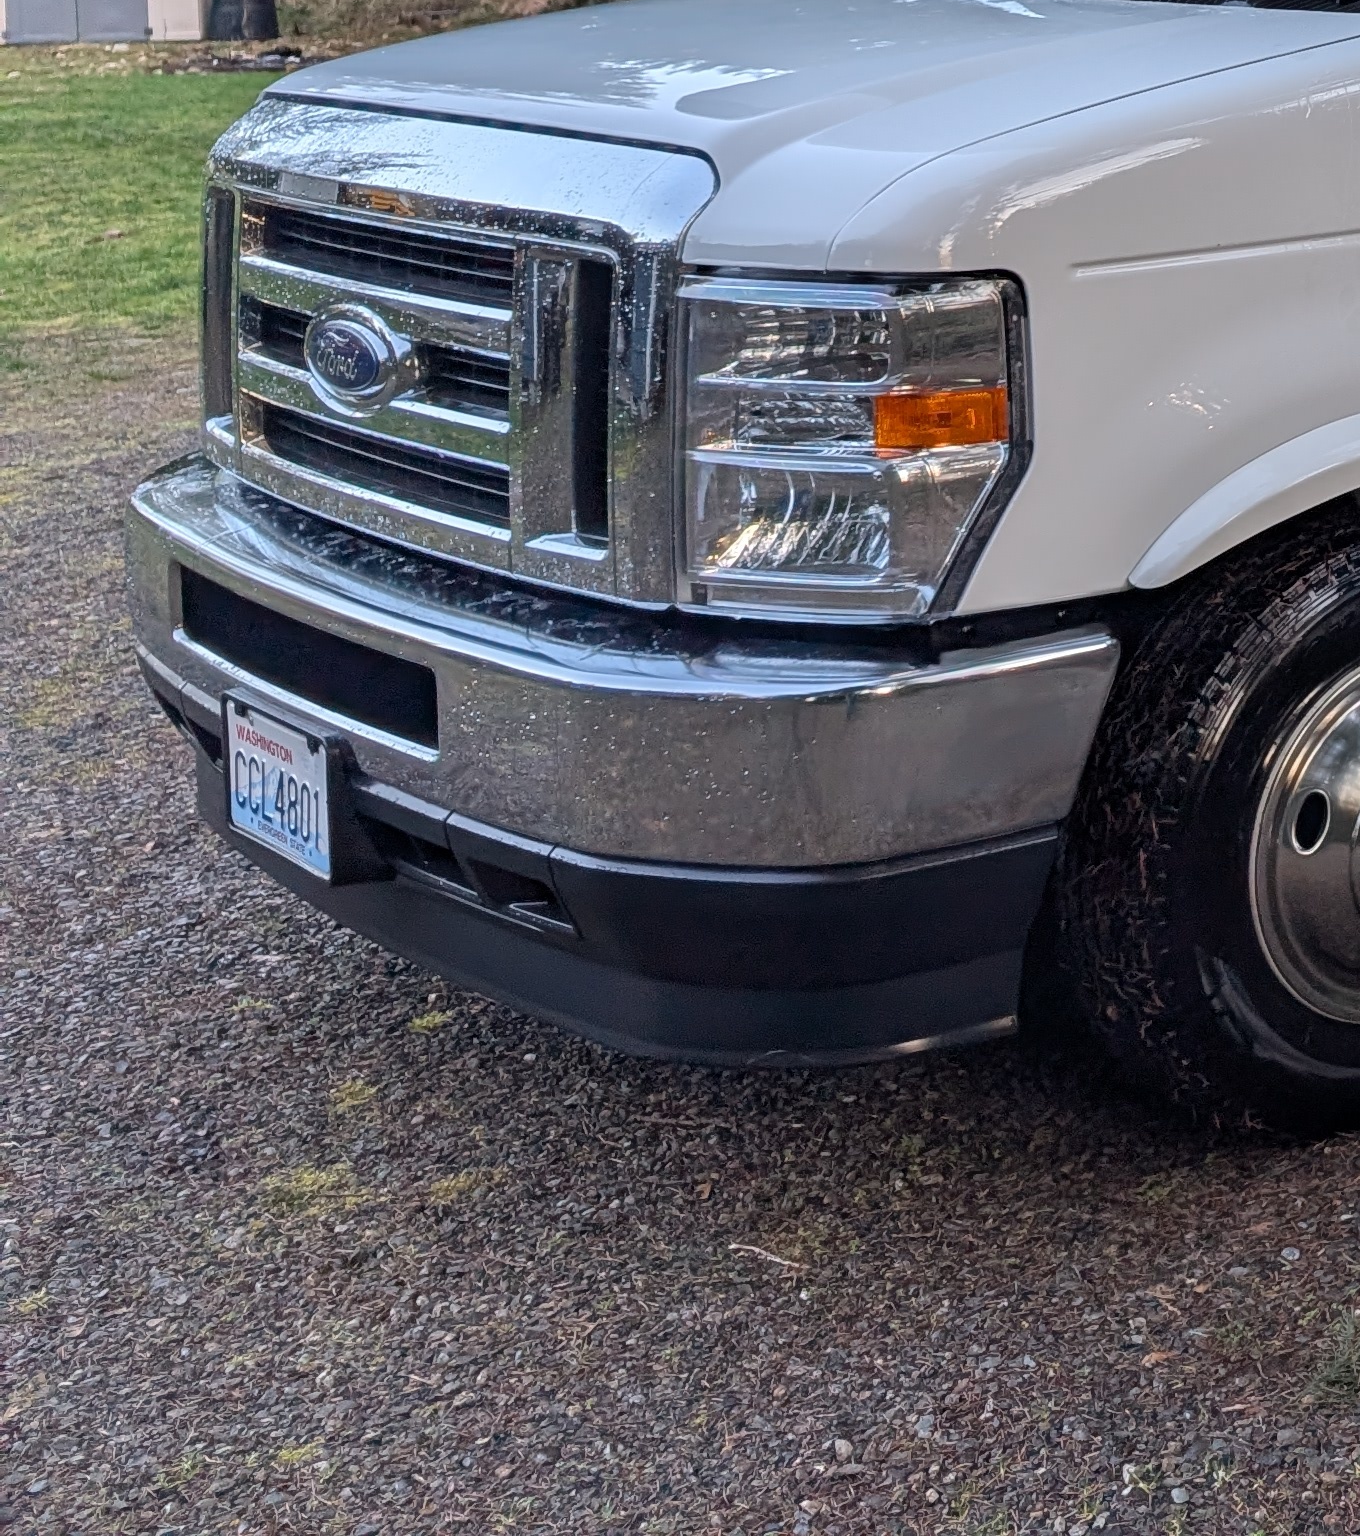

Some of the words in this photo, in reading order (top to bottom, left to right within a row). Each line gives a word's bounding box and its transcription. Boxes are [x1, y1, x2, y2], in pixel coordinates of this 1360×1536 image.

[317, 332, 358, 381] Ford
[235, 724, 293, 765] WASHINGTON
[235, 749, 320, 850] CCL4801
[257, 820, 288, 844] EVERGREEN
[289, 838, 306, 856] STATE
